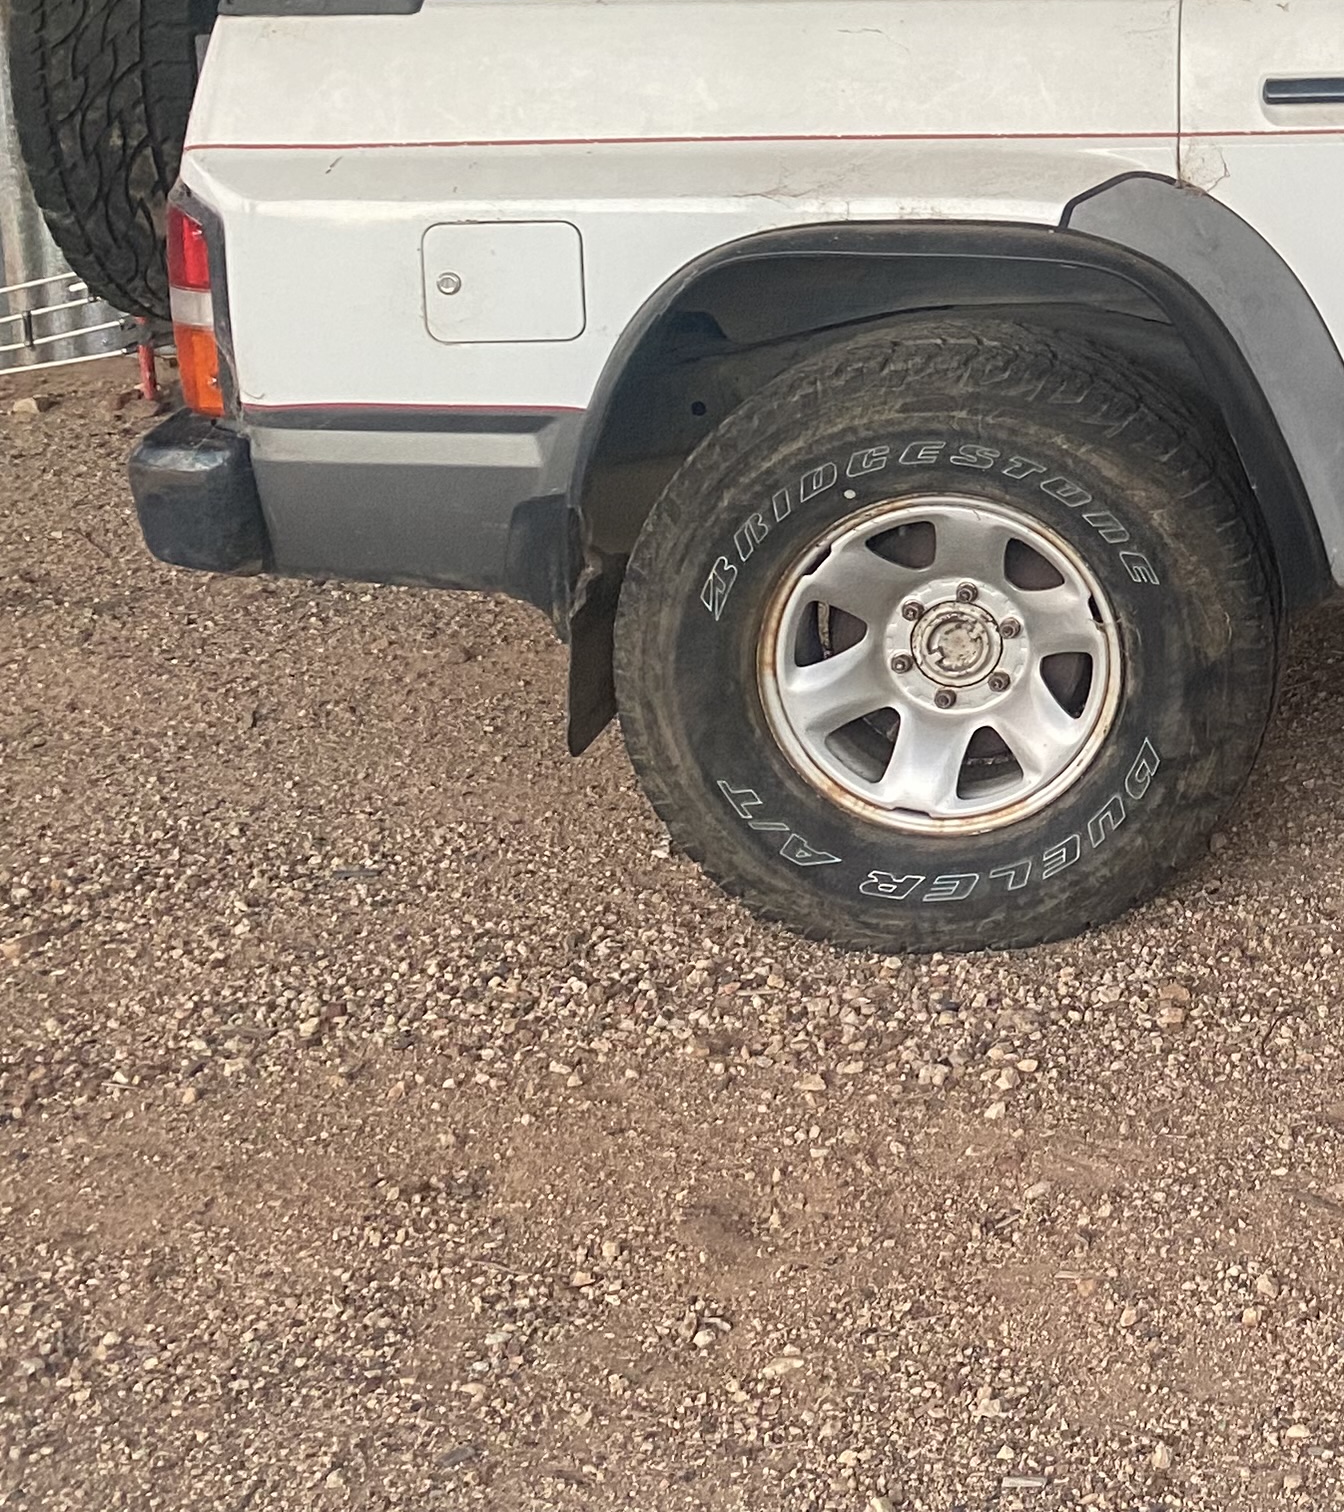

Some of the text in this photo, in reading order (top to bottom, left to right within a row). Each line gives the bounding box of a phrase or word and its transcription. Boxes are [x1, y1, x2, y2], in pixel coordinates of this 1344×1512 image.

[699, 440, 1160, 621] BRIDGESTONE
[717, 737, 1160, 903] DUELER A/T
